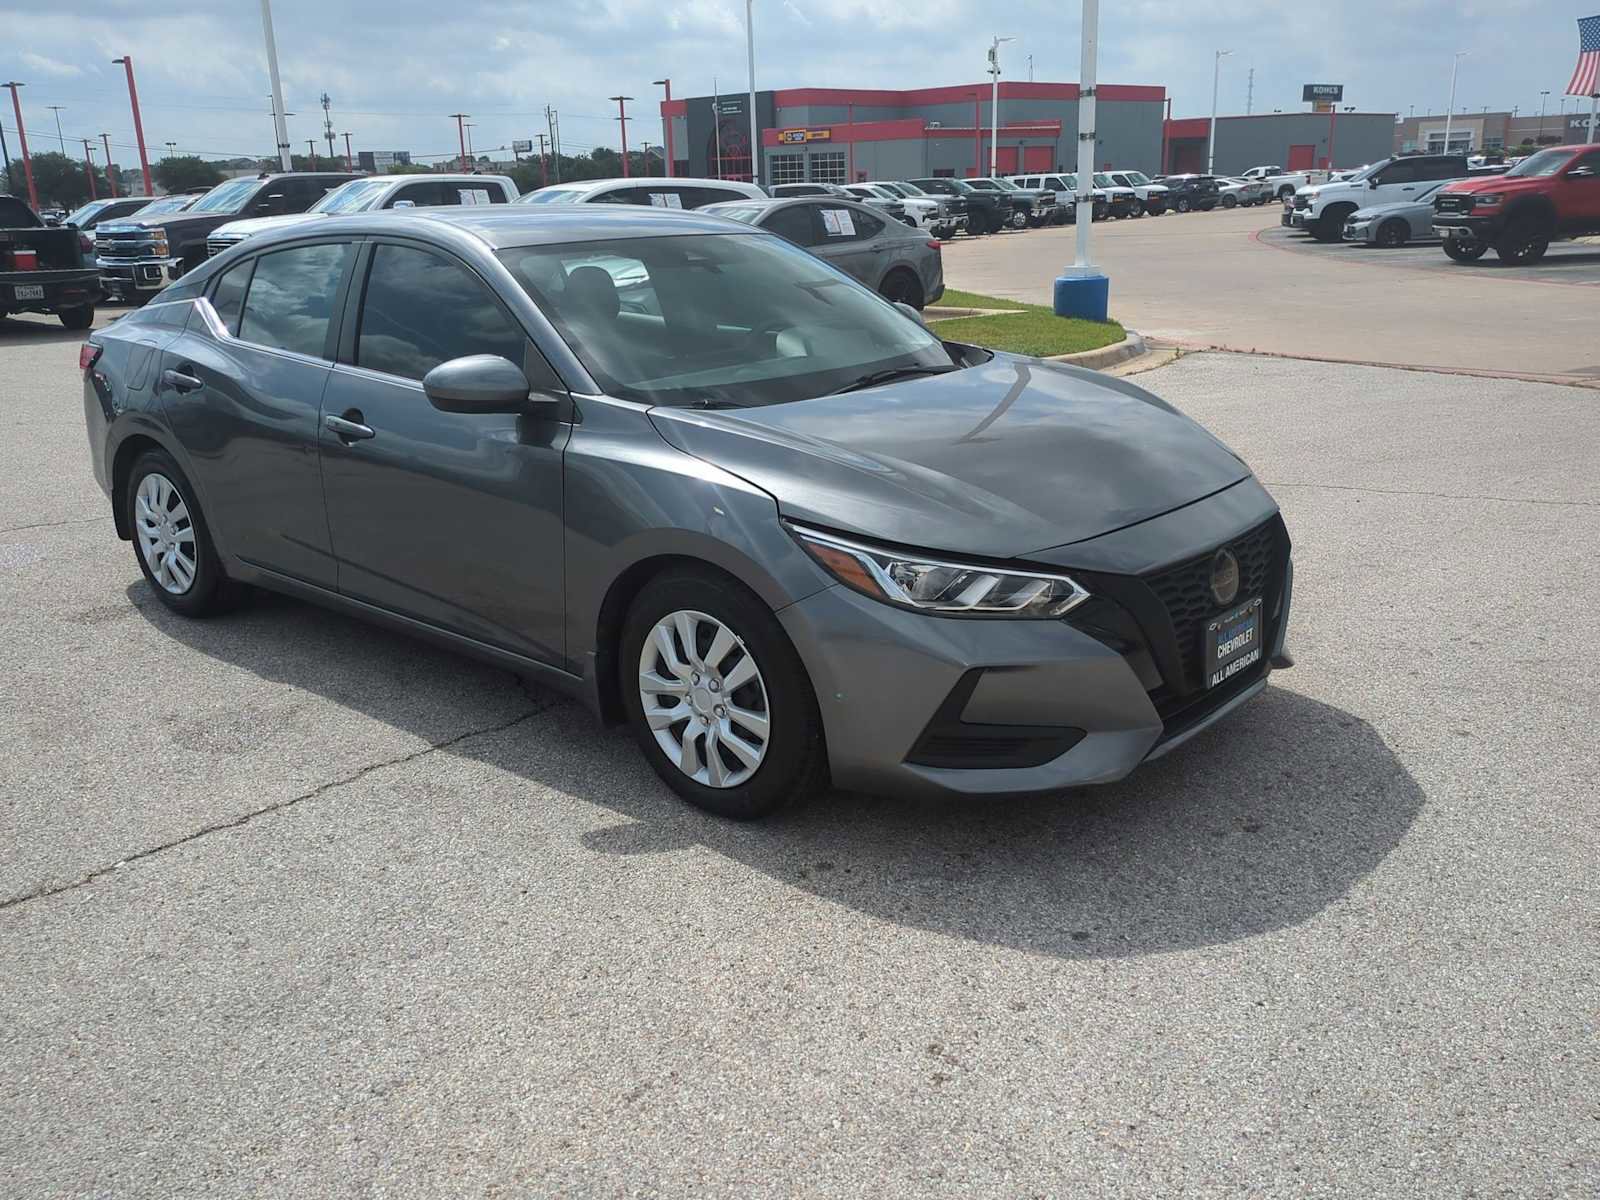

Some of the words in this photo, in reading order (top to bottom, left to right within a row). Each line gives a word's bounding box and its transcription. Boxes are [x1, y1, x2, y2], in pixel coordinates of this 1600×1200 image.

[1217, 627, 1254, 659] CHEVROLET
[1211, 670, 1225, 687] ALL
[1225, 648, 1259, 679] AMERICAN
